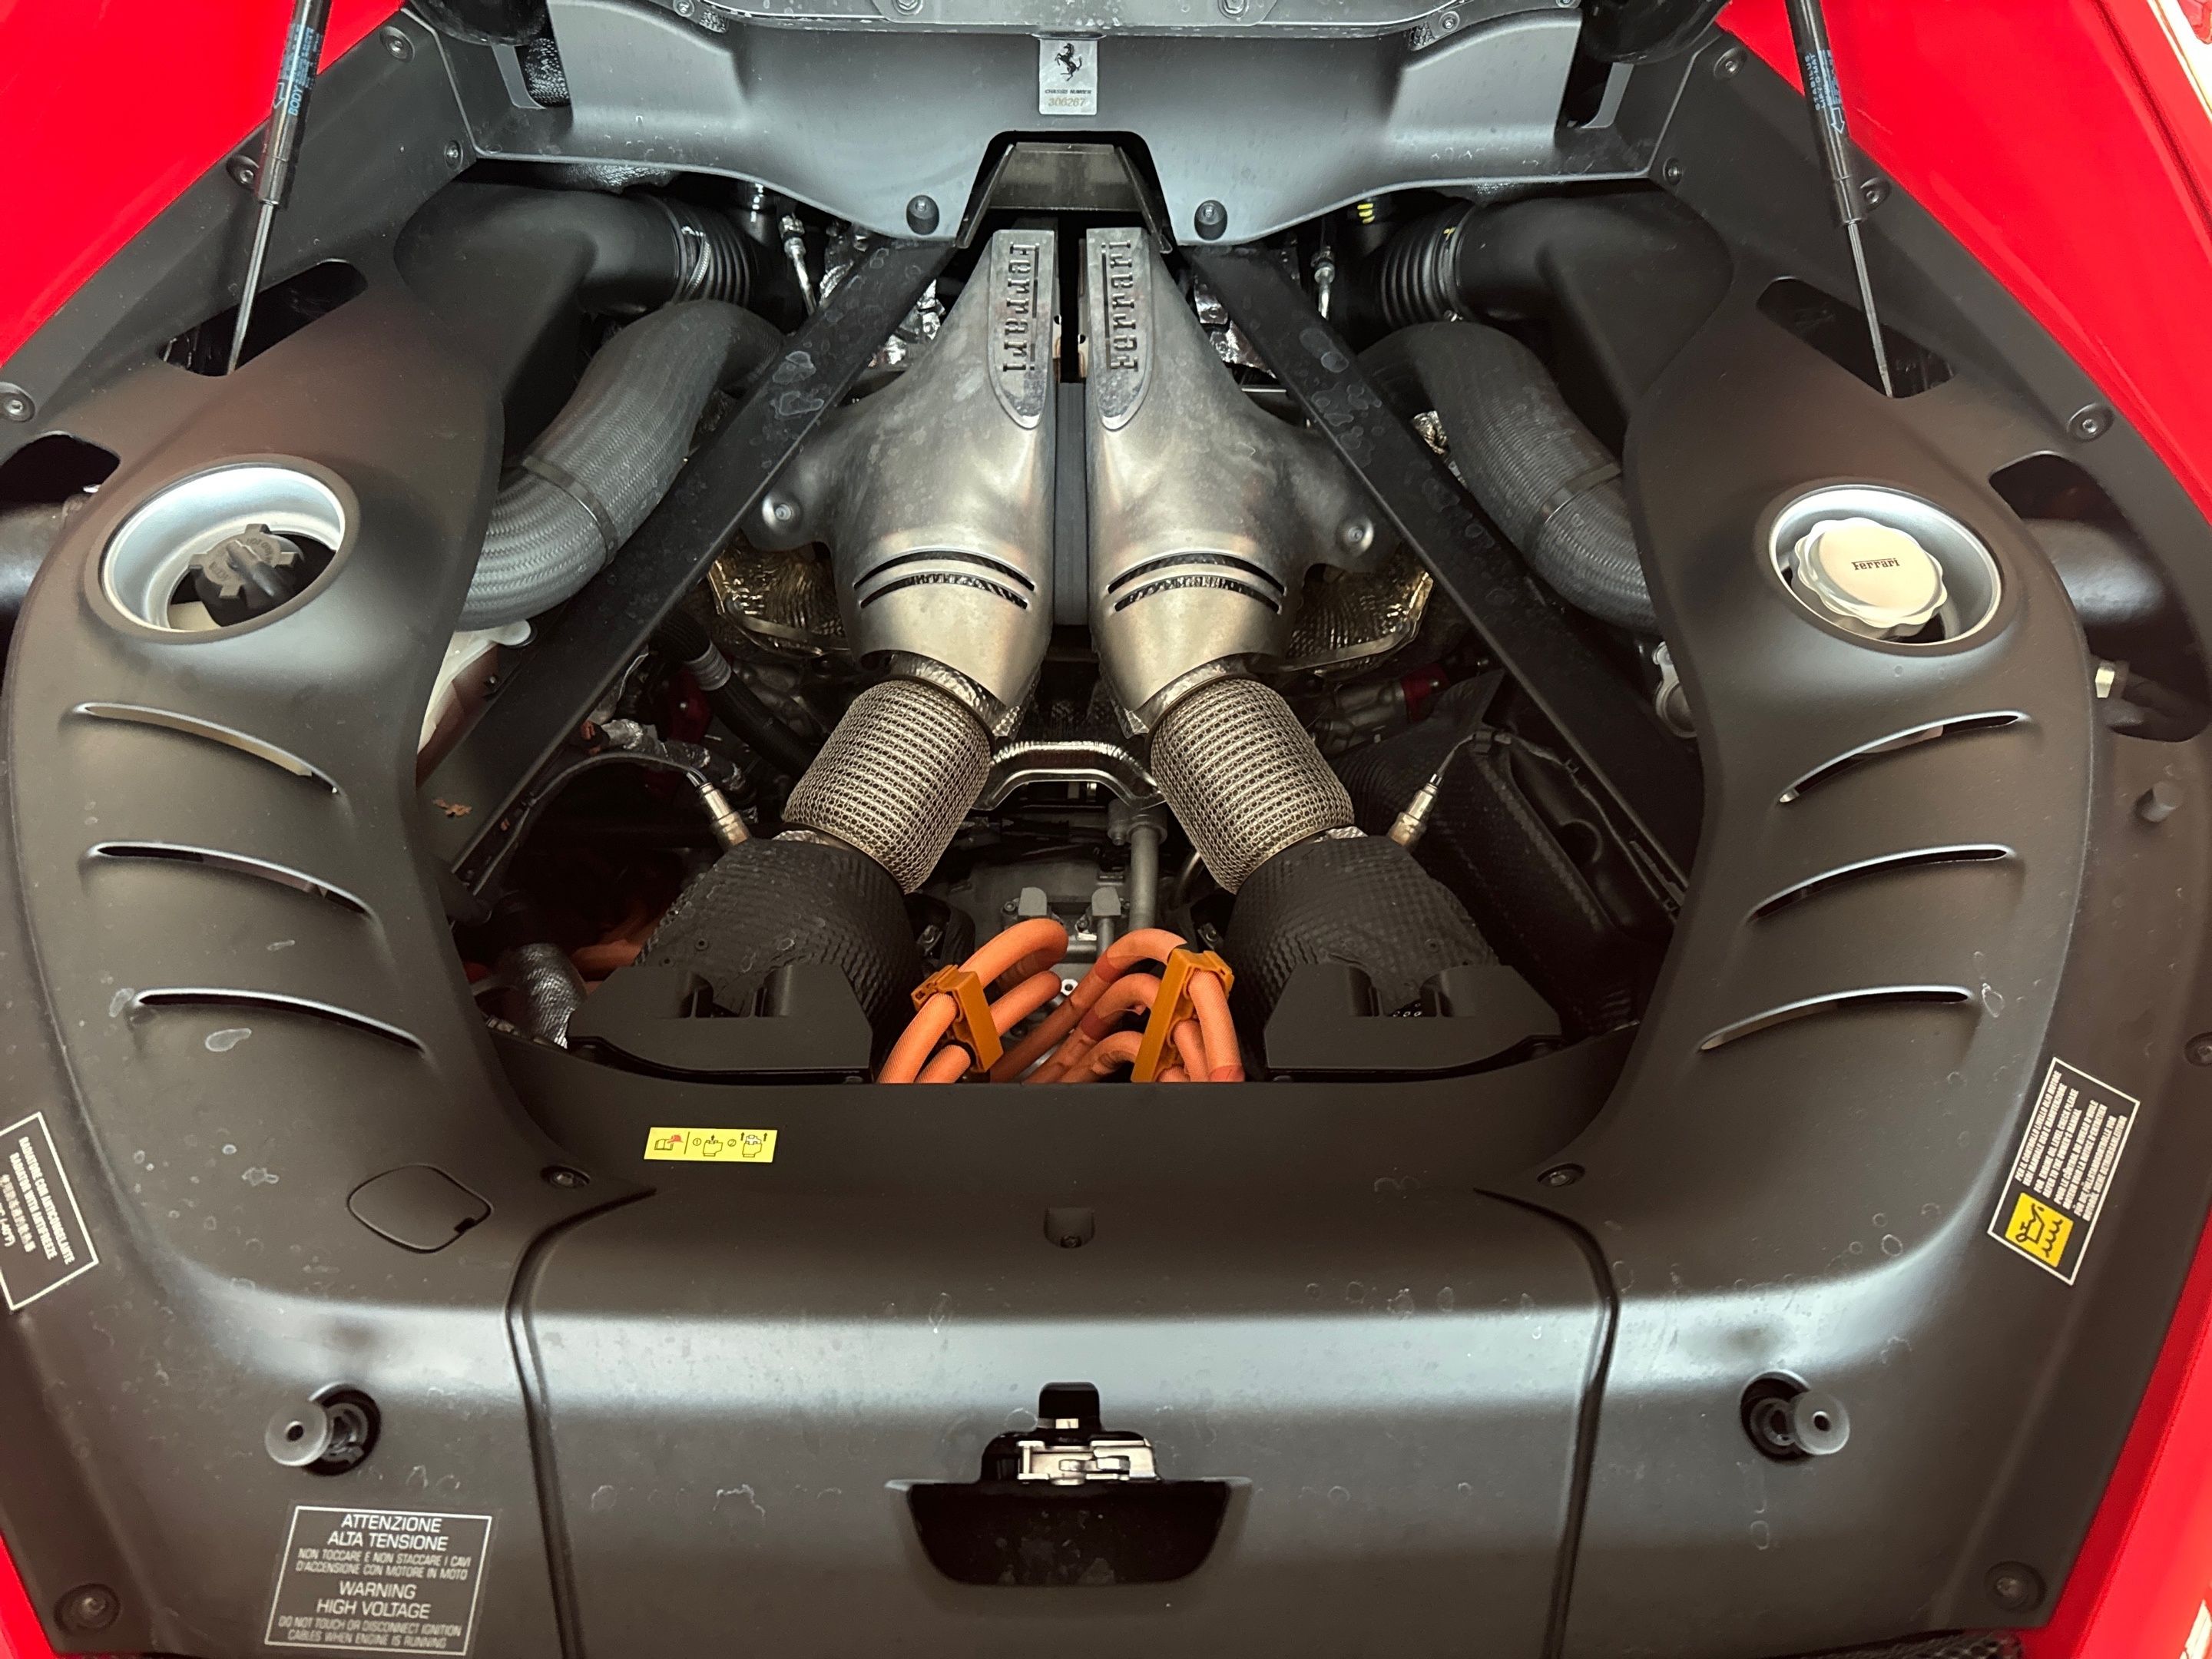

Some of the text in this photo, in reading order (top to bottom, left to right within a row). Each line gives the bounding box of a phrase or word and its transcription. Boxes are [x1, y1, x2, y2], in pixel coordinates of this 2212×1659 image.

[288, 85, 303, 116] BODY
[1002, 241, 1040, 372] Ferrari
[1101, 240, 1139, 373] Ferrari
[1852, 558, 1900, 571] Ferrari
[2022, 1129, 2040, 1163] CONTROLLO
[2034, 1107, 2048, 1130] LIVELLO
[2048, 1071, 2061, 1094] MOTORE
[2066, 1109, 2081, 1134] MANUAL
[2034, 1180, 2045, 1193] FOR
[2051, 1130, 2063, 1147] LEVEL
[2058, 1110, 2071, 1130] CHECK
[2065, 1089, 2078, 1111] PLEASE
[341, 1514, 442, 1533] ATTENZIONE
[327, 1531, 449, 1551] ALTA TENSIONE
[298, 1548, 319, 1559] NON
[323, 1549, 362, 1561] TOCCARE
[364, 1551, 370, 1562] E
[373, 1552, 393, 1563] NON
[396, 1553, 441, 1565] STACCARE
[450, 1556, 471, 1567] CAVI
[296, 1561, 468, 1580] D'ACCENSIONE CON MOTORE IN MOTO
[340, 1581, 416, 1599] WARNING
[316, 1599, 431, 1619] HIGH VOLTAGE
[278, 1616, 462, 1636] DO NOT TOUCH OR DISCONNECT IGNITION
[288, 1629, 322, 1641] CABLES
[325, 1632, 353, 1643] WHEN
[355, 1633, 389, 1645] ENGINE
[404, 1636, 446, 1648] RUNNING
